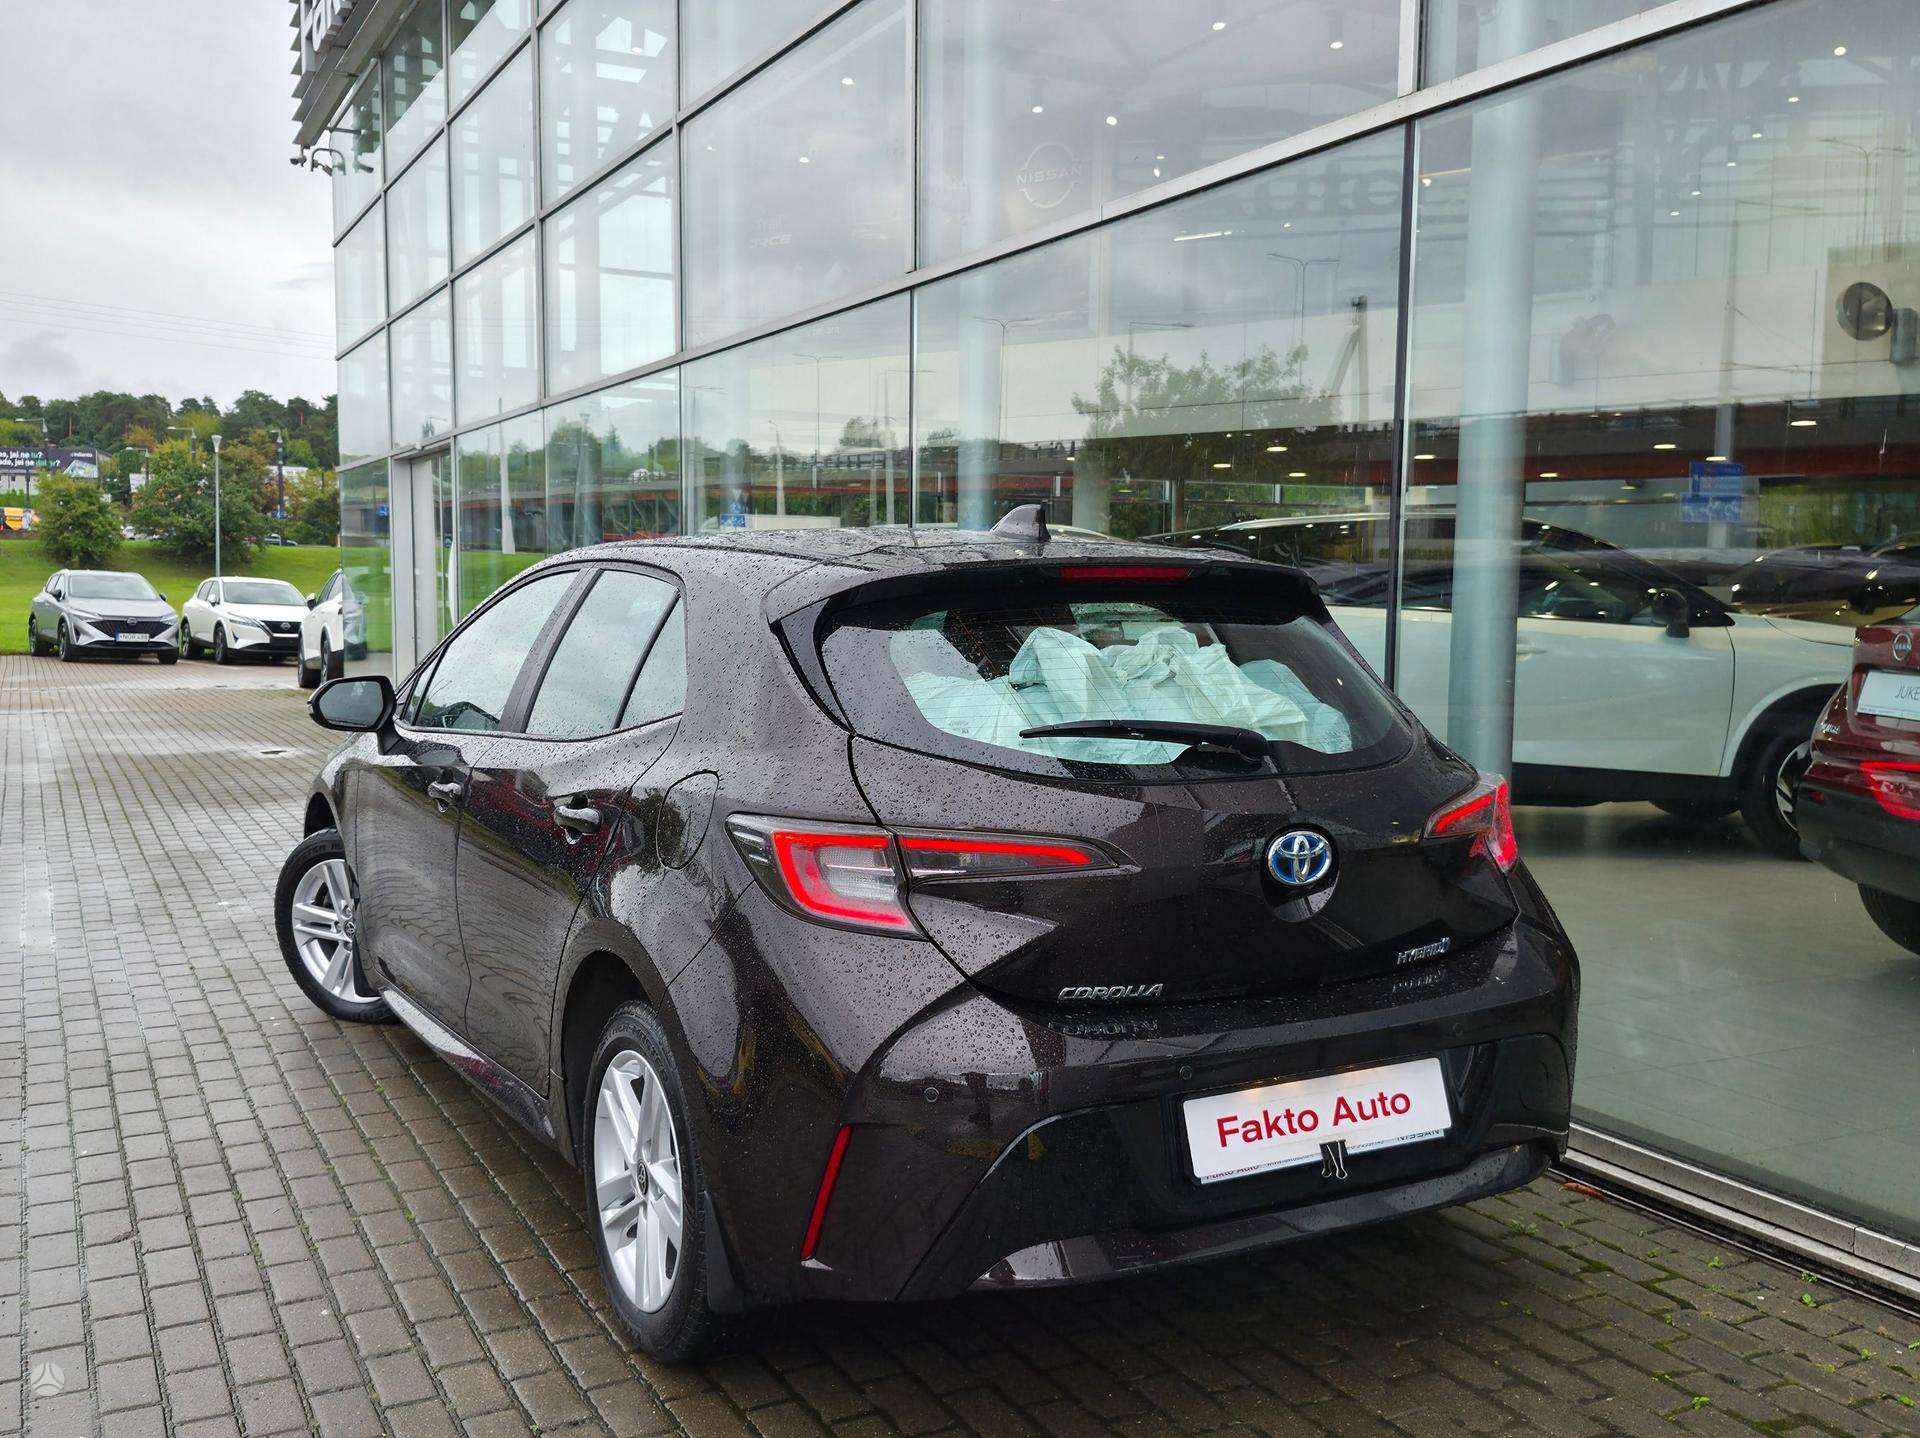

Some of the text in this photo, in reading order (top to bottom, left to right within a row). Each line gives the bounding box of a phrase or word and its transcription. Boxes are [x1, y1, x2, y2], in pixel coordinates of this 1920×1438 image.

[1058, 983, 1164, 1000] COROLLA
[1217, 1092, 1411, 1147] Fakto Auto
